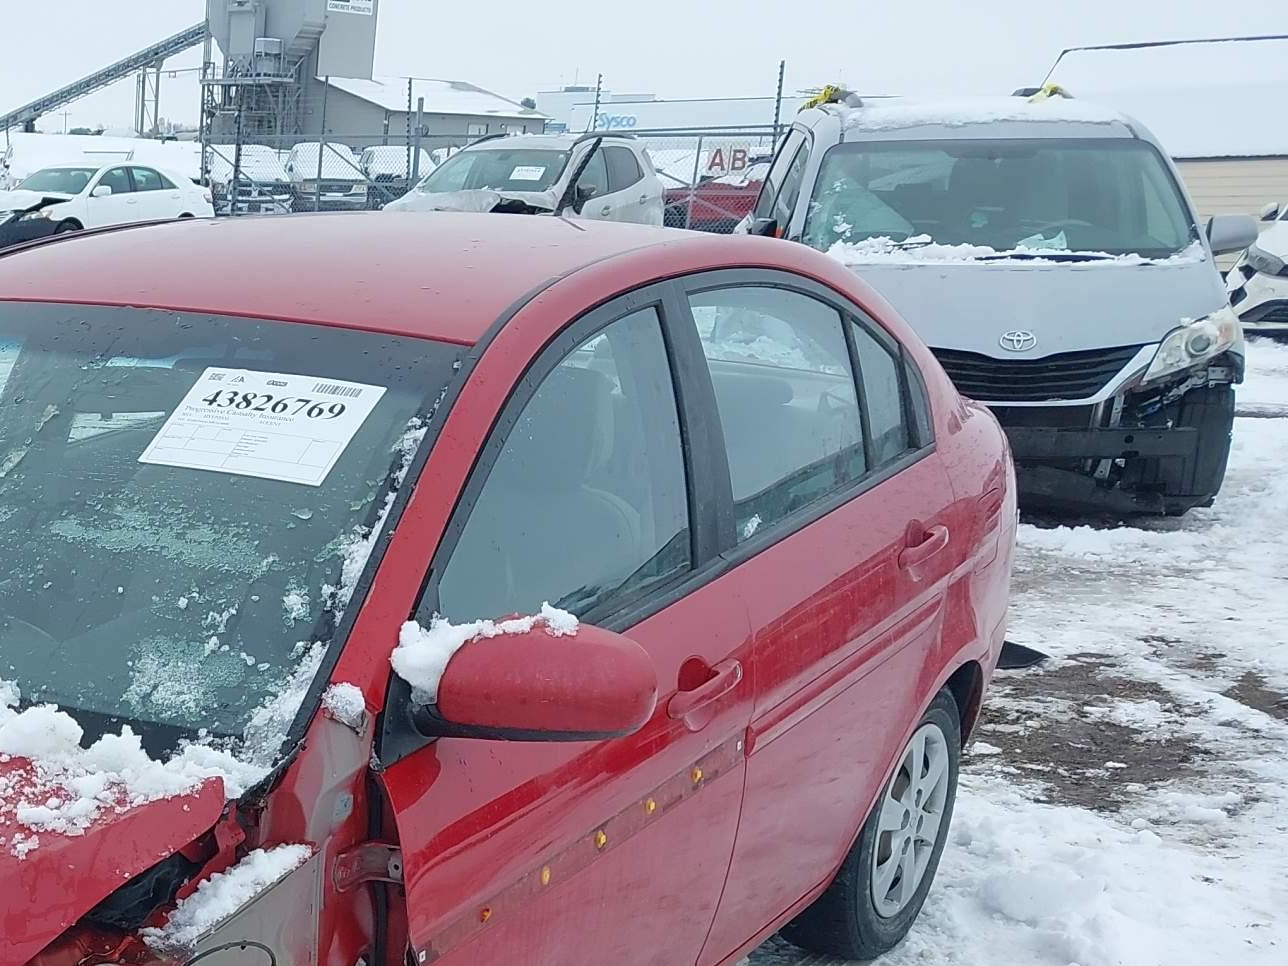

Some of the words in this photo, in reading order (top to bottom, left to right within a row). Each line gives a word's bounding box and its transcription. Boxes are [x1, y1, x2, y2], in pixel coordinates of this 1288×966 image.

[329, 3, 350, 11] CONCRETE
[598, 112, 637, 130] Sysco
[201, 389, 346, 420] 43826769
[184, 405, 225, 415] Progressive
[226, 409, 258, 419] Casualty
[259, 412, 295, 423] Insurance
